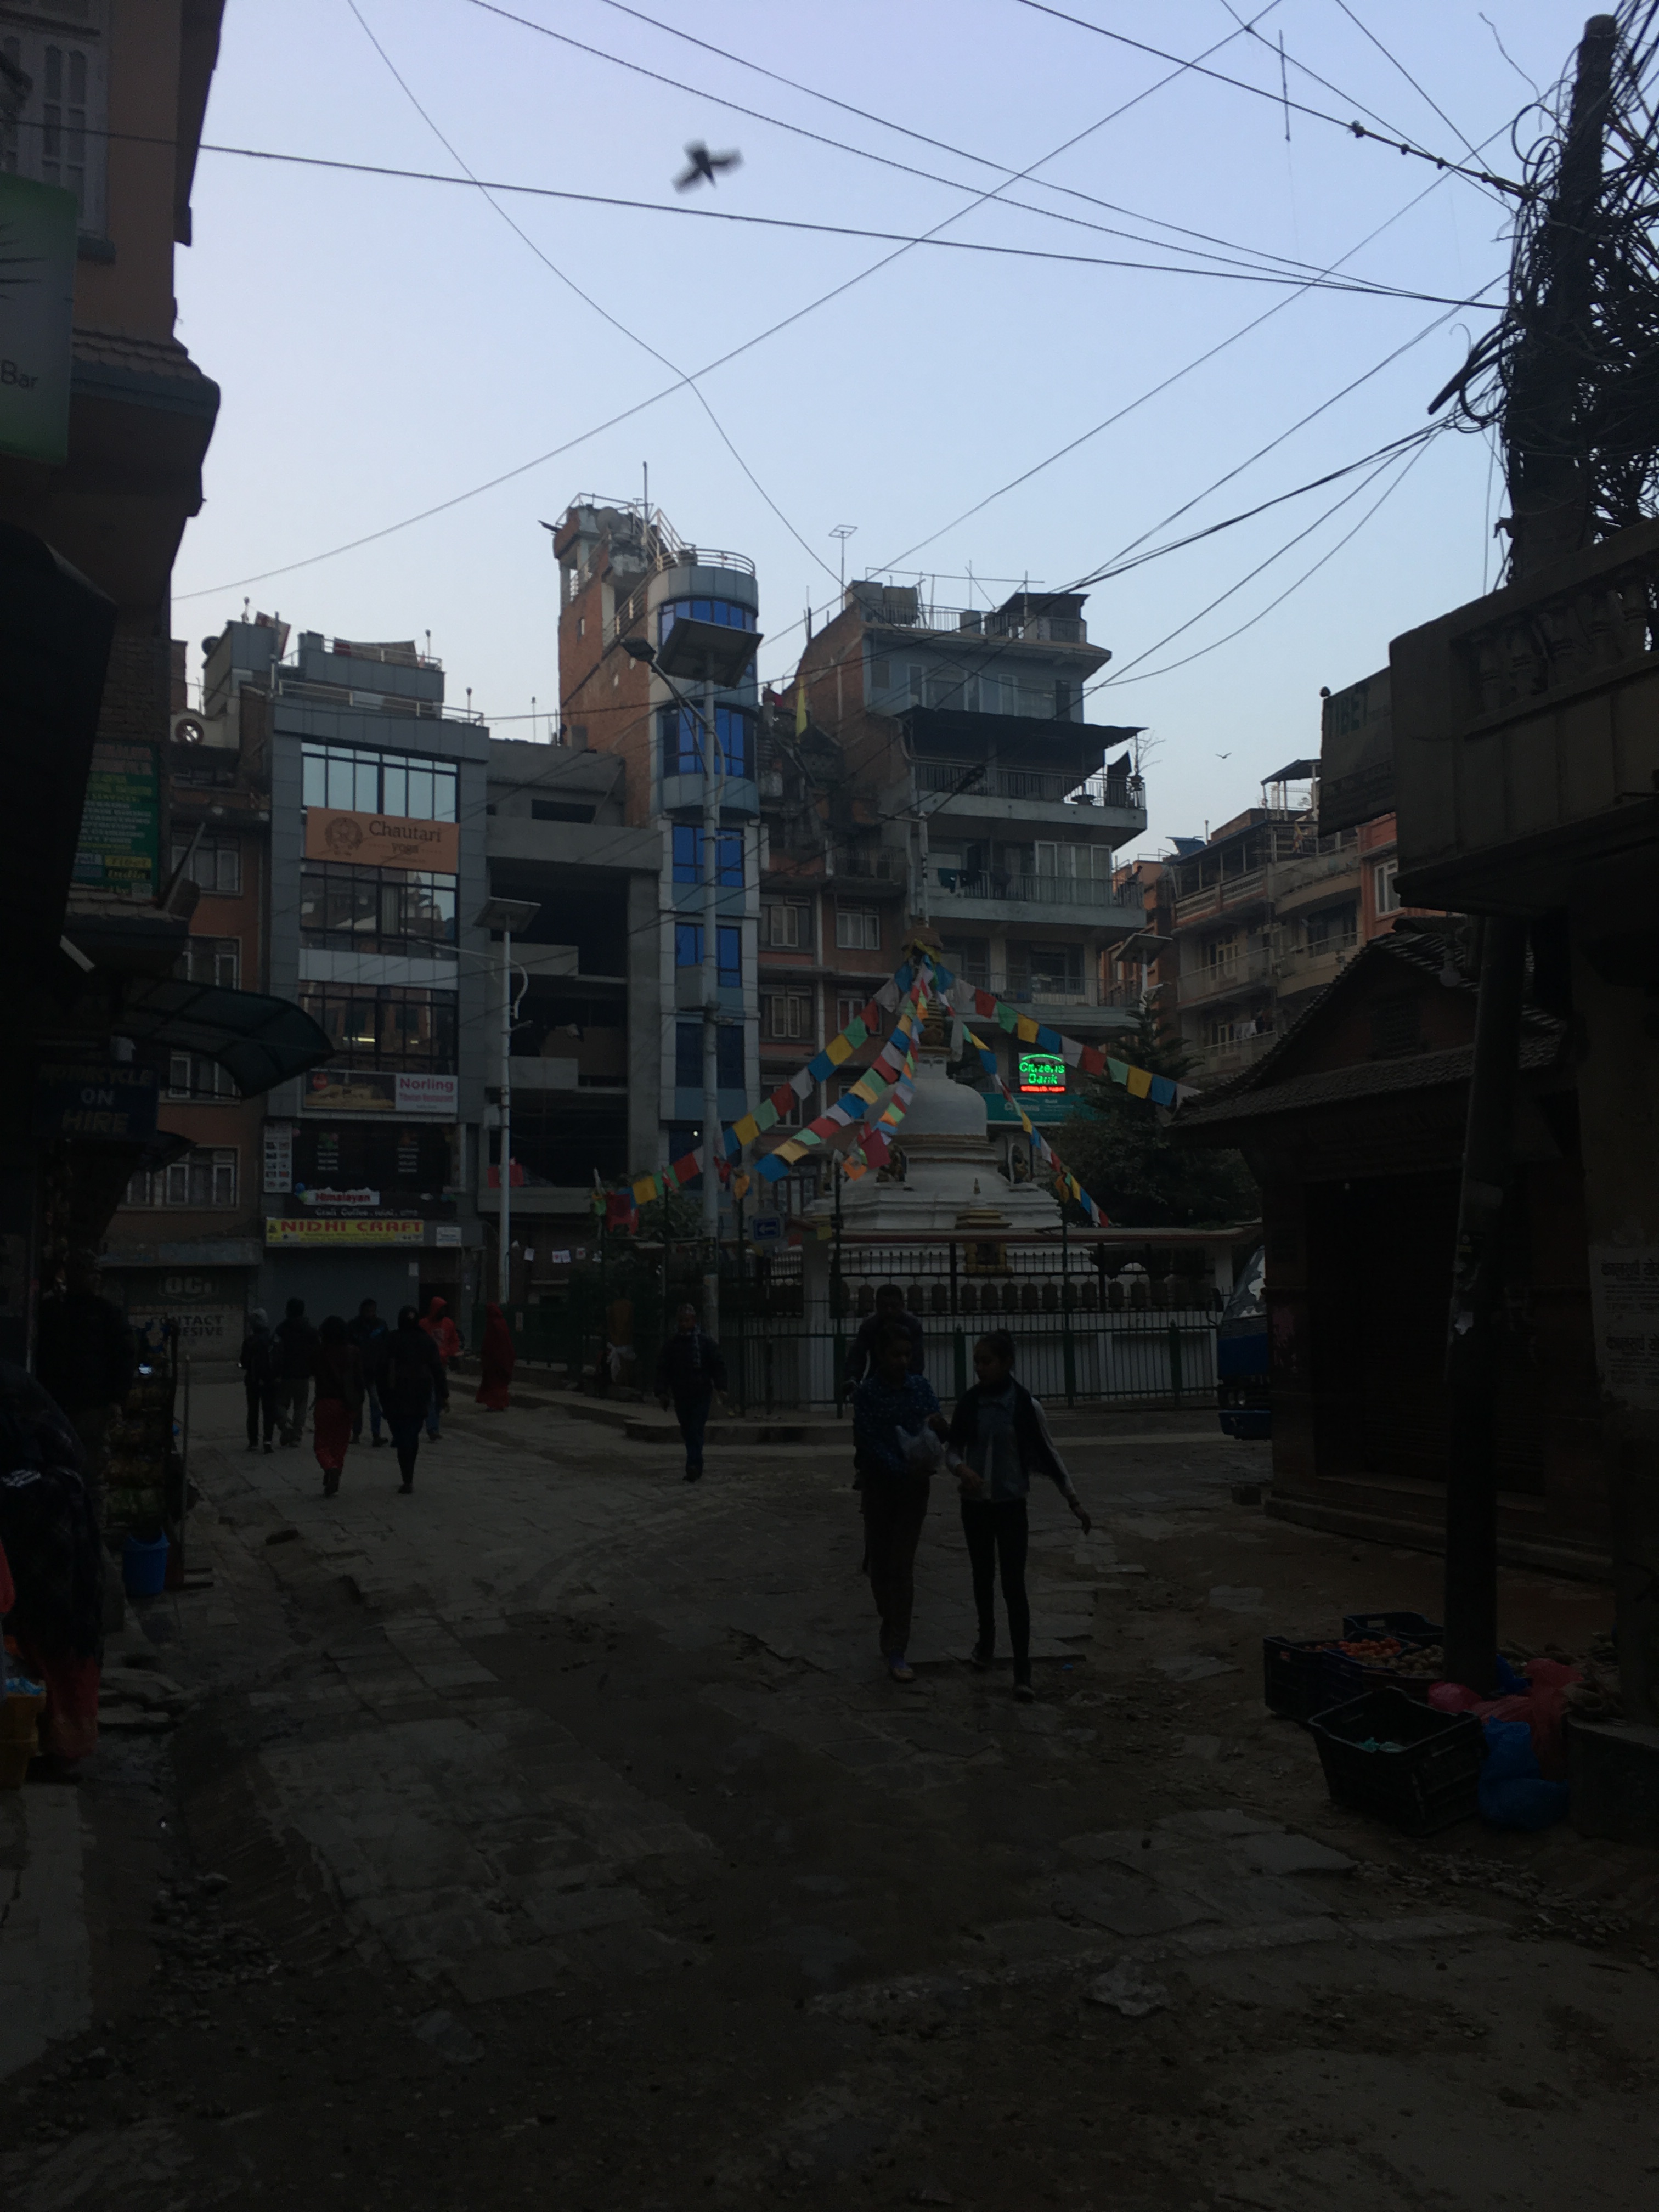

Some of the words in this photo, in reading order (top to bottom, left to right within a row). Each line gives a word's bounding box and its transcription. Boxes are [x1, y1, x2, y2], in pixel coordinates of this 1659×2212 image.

[1, 360, 38, 389] Bar
[1325, 683, 1370, 740] TIBET
[369, 820, 441, 843] Chautari
[400, 1078, 454, 1093] Norling
[81, 1087, 115, 1106] ON
[61, 1109, 130, 1134] HIRE
[315, 1192, 371, 1203] Himalayan
[280, 1221, 346, 1232] NIDHI
[357, 1221, 423, 1232] CRAFT
